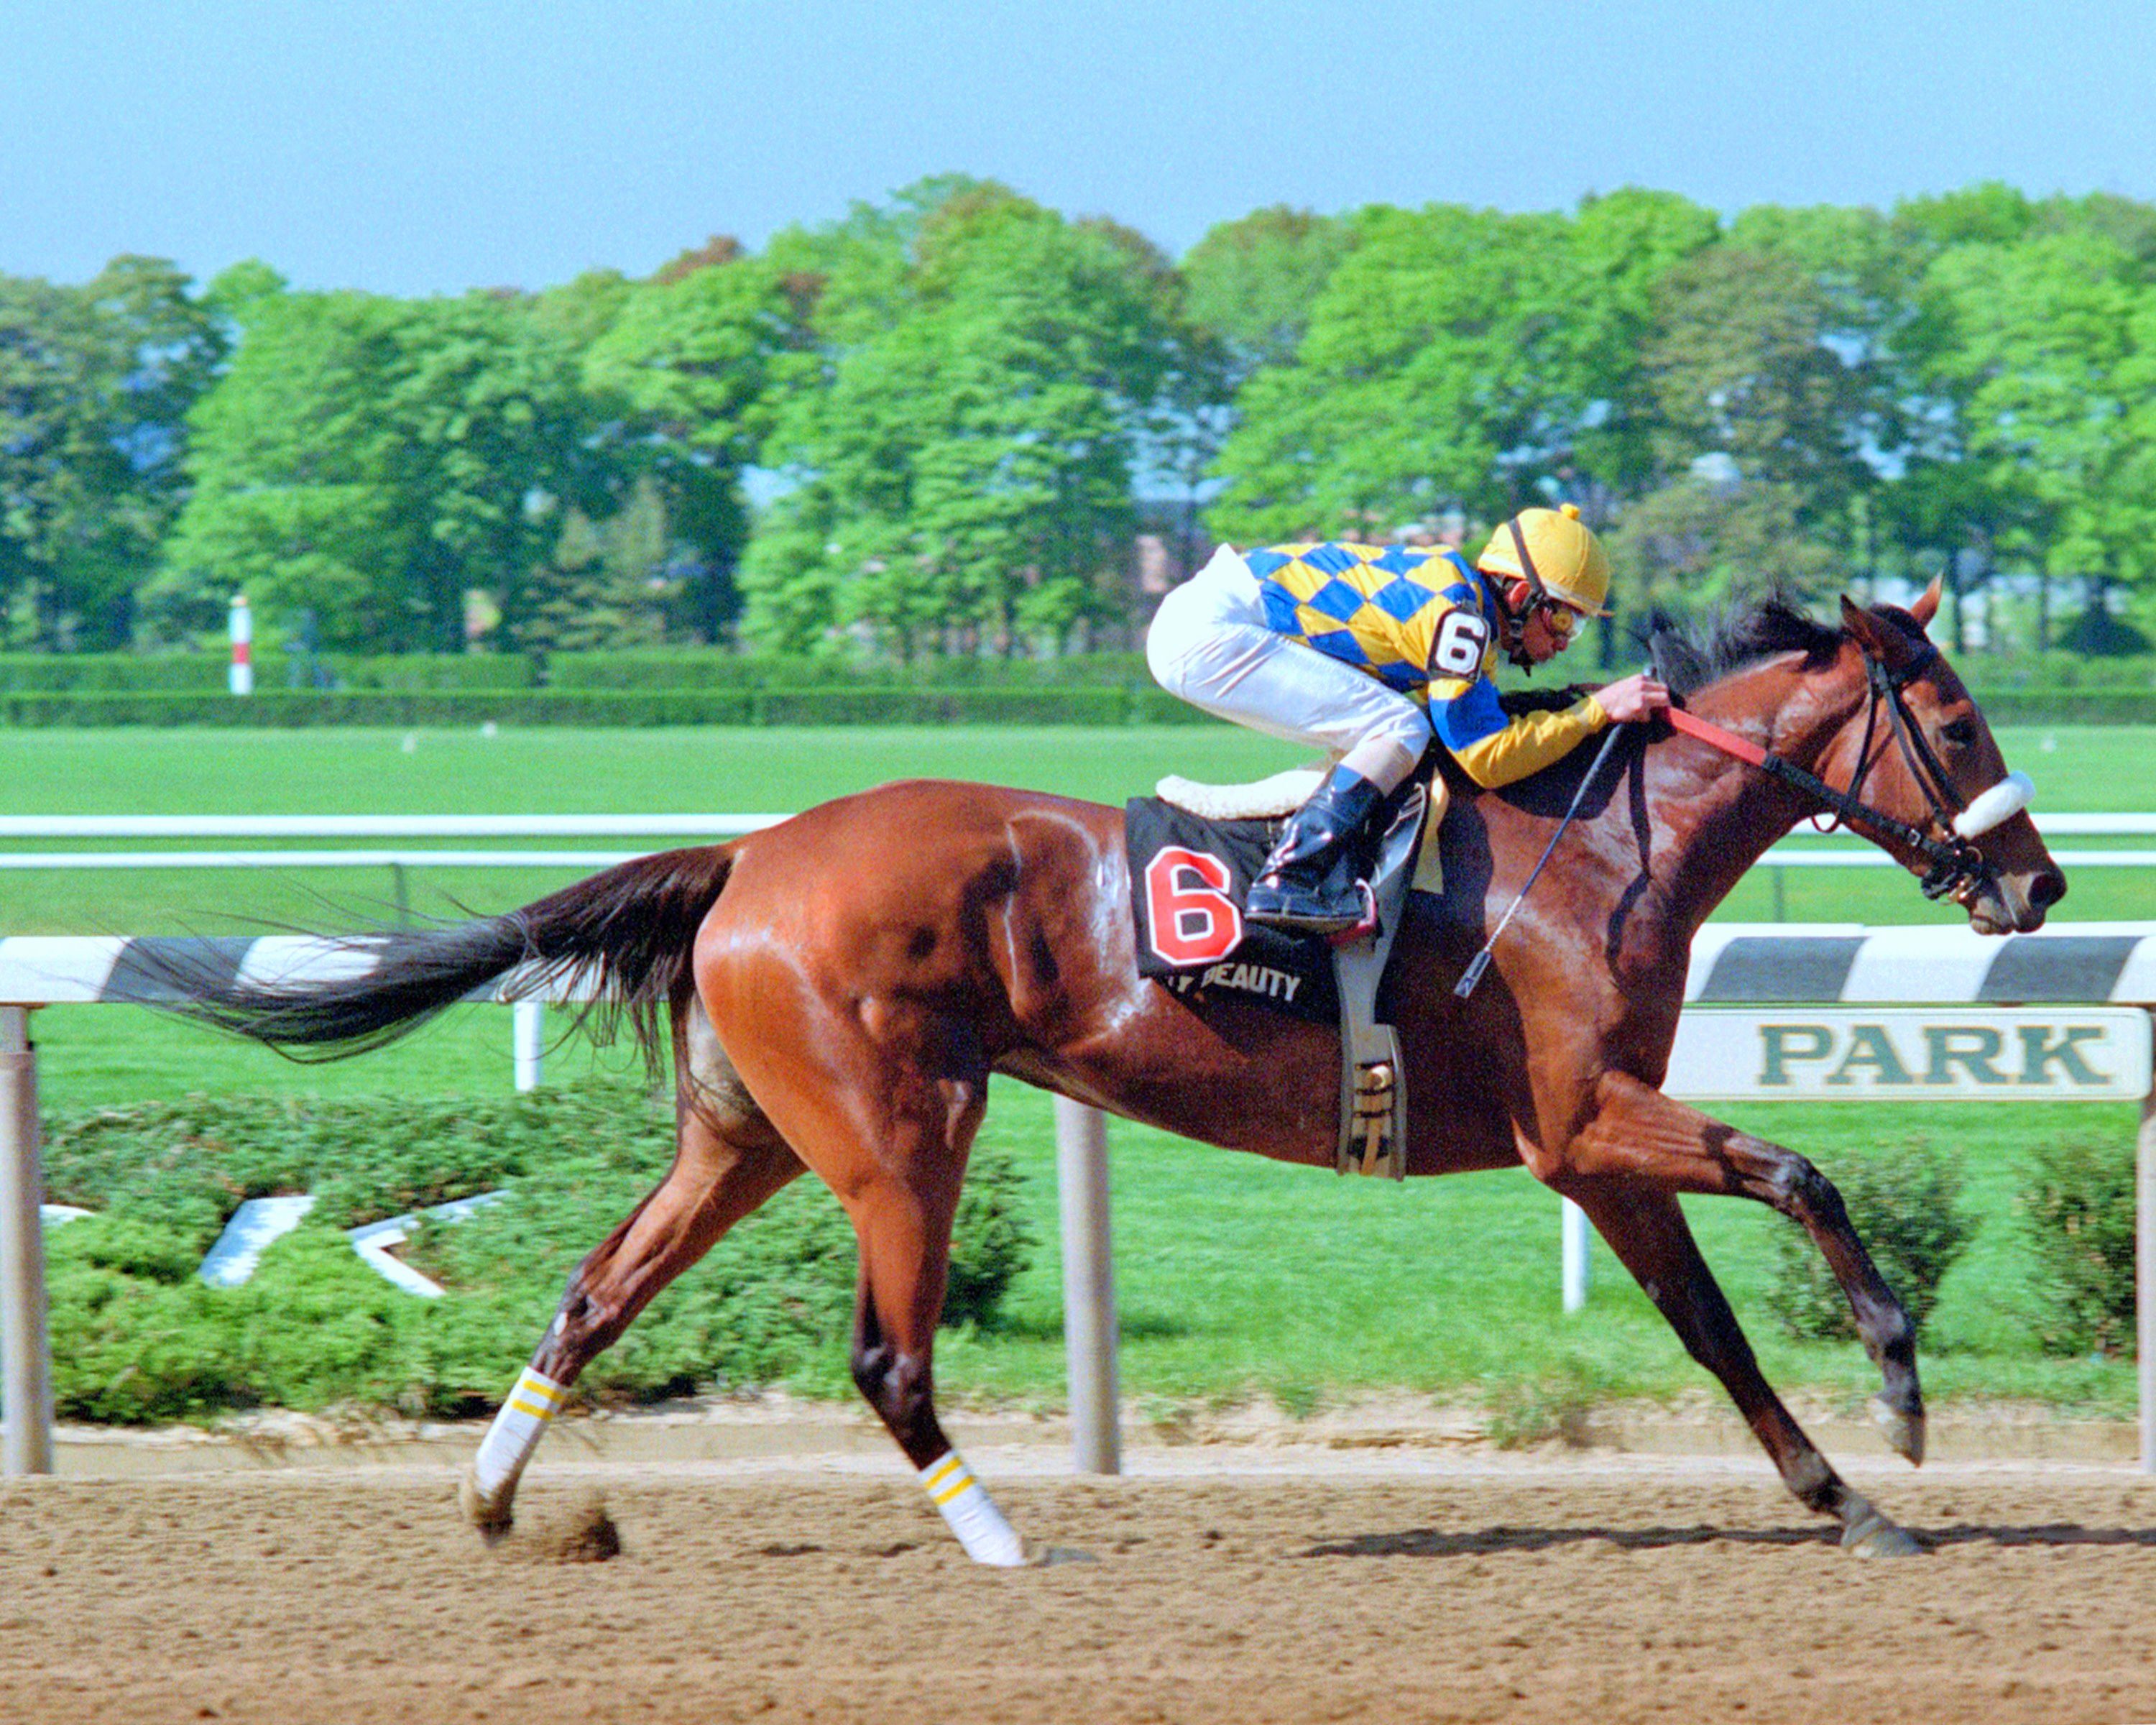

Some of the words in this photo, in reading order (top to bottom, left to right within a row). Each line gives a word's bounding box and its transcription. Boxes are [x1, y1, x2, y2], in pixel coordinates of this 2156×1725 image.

[1436, 612, 1485, 673] 6
[1145, 845, 1242, 965] 6
[1200, 962, 1301, 1001] BEAUTY
[1758, 1024, 2111, 1086] PARK
